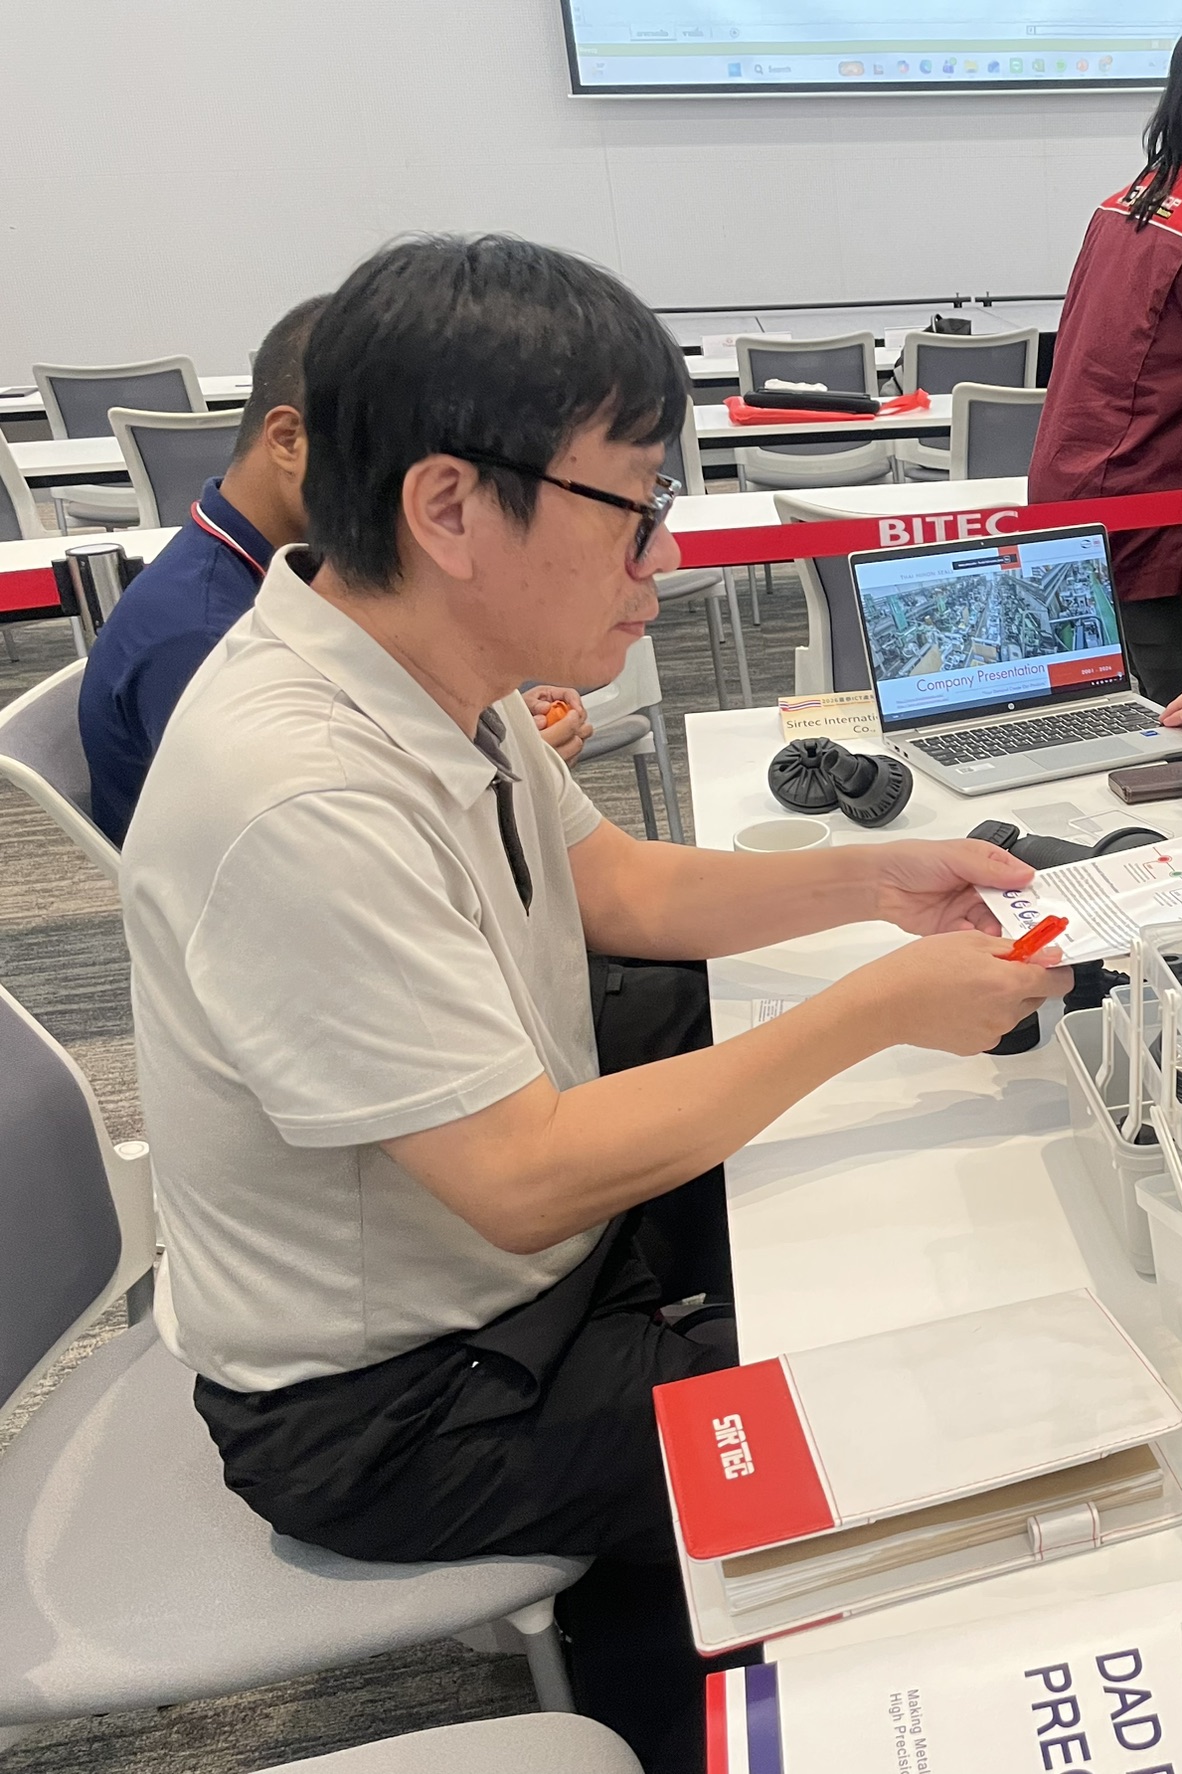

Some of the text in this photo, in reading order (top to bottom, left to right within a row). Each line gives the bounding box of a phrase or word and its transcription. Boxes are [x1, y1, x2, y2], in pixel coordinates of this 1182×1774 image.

[879, 510, 1019, 547] BITEC
[916, 663, 1046, 693] Company Presentation
[787, 717, 822, 729] Sirtec
[888, 1692, 905, 1722] High
[1024, 1662, 1093, 1774] PRE
[1095, 1648, 1162, 1751] DAD
[907, 1689, 931, 1774] Making Metal
